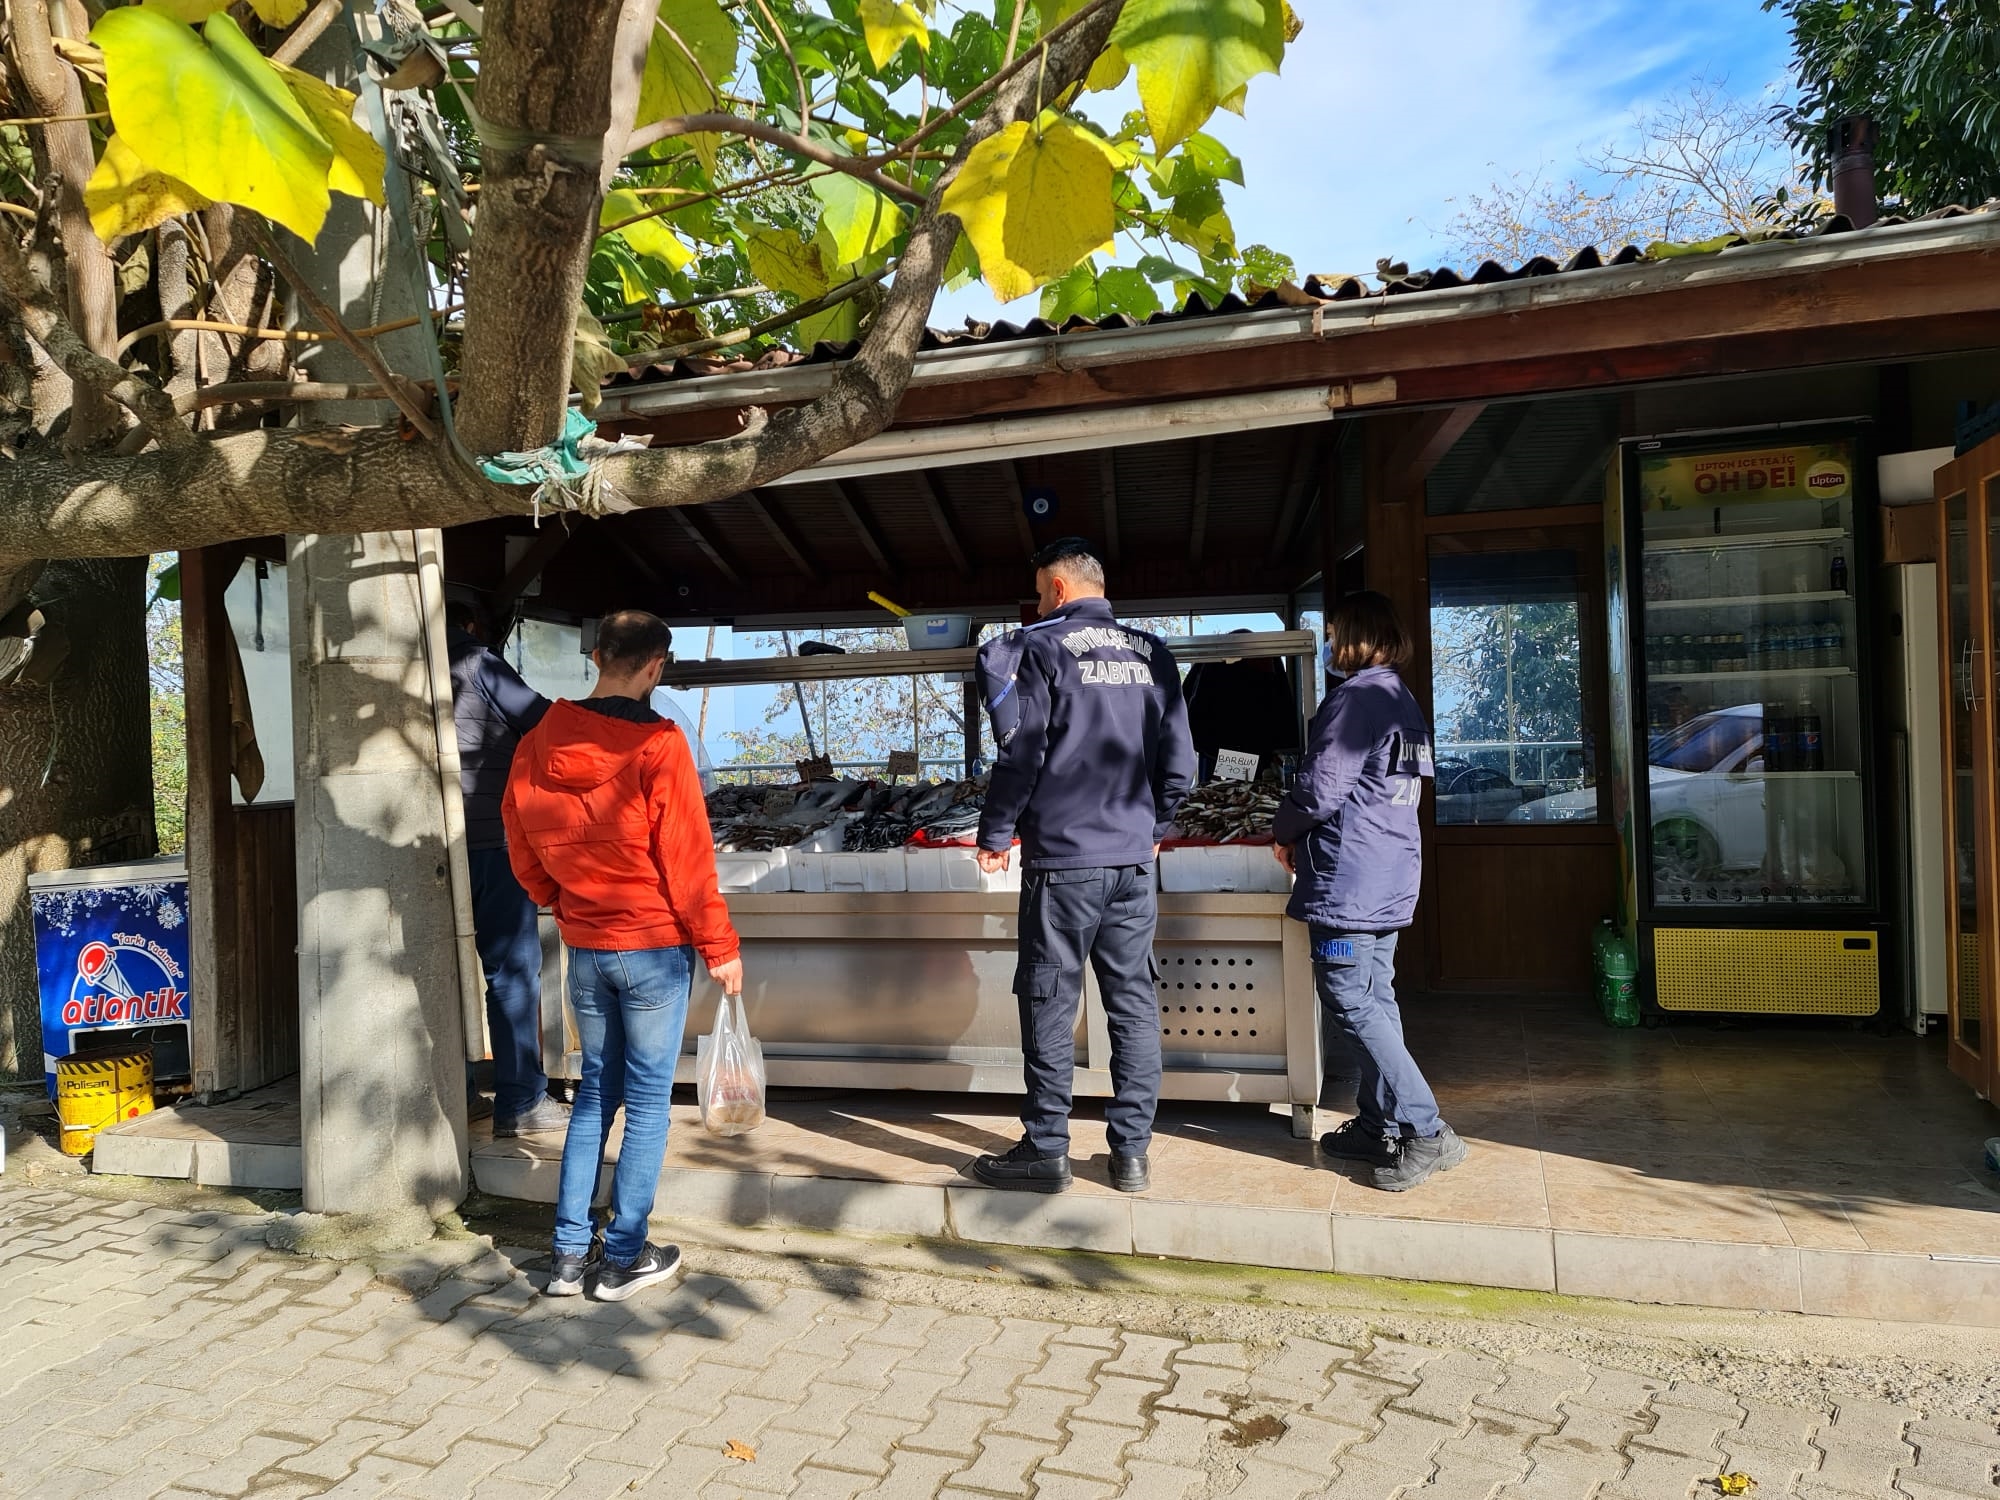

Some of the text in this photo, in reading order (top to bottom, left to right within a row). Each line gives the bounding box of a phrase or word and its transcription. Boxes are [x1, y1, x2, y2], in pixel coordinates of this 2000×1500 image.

[1696, 462, 1734, 471] LIPTON
[1738, 459, 1757, 469] ICE
[1760, 457, 1780, 466] TEA
[1695, 467, 1796, 494] OH DE!
[1812, 476, 1842, 486] Lipton
[1078, 661, 1155, 686] ZABITA
[63, 988, 187, 1024] atlantik
[66, 1080, 110, 1090] Polisan
